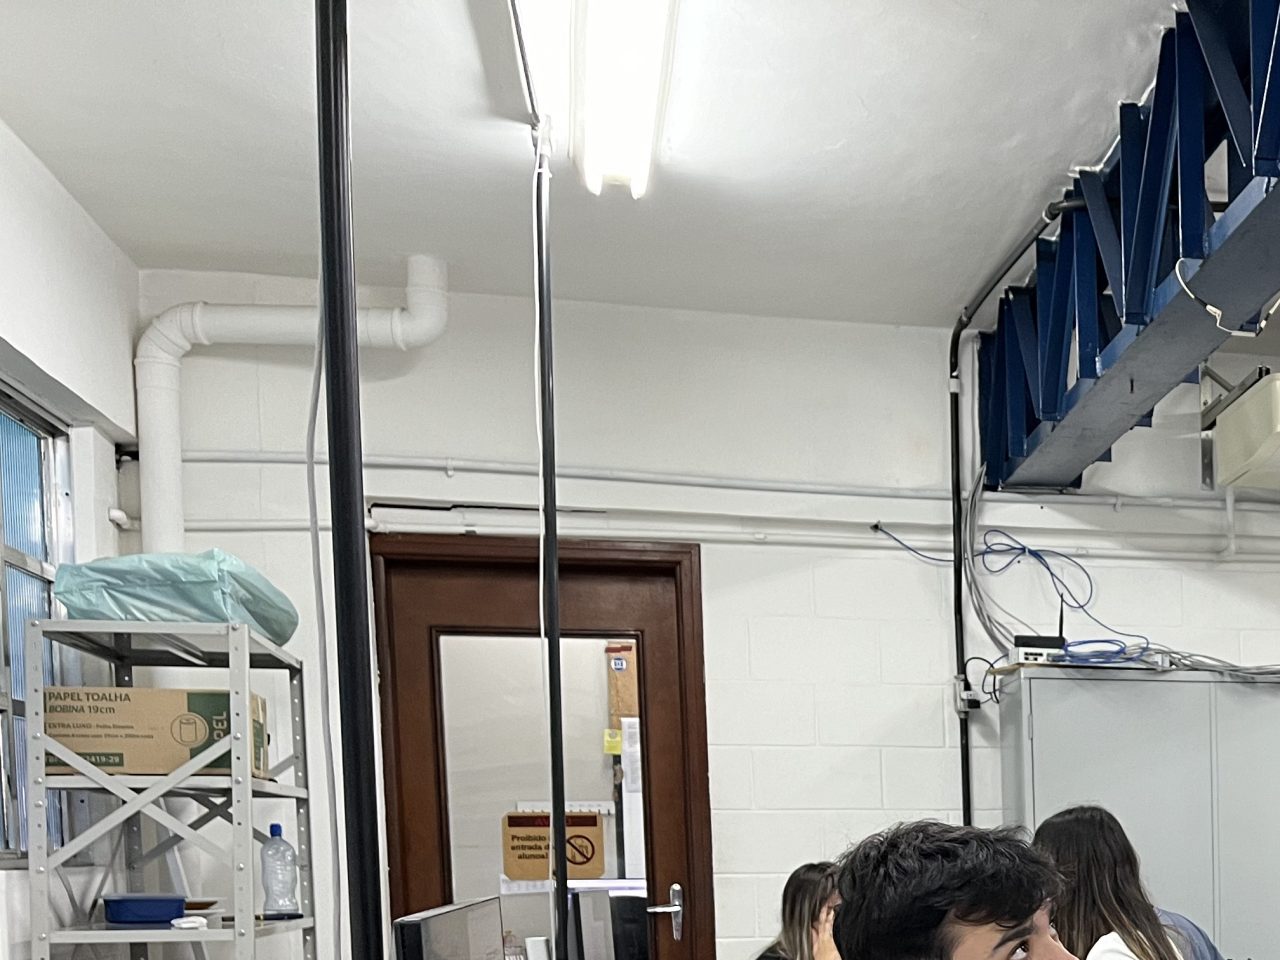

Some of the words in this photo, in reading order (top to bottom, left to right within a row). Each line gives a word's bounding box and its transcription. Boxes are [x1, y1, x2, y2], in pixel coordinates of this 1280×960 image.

[48, 691, 83, 701] PAPEL
[84, 692, 132, 702] TOALHA
[48, 704, 86, 714] BOBINA
